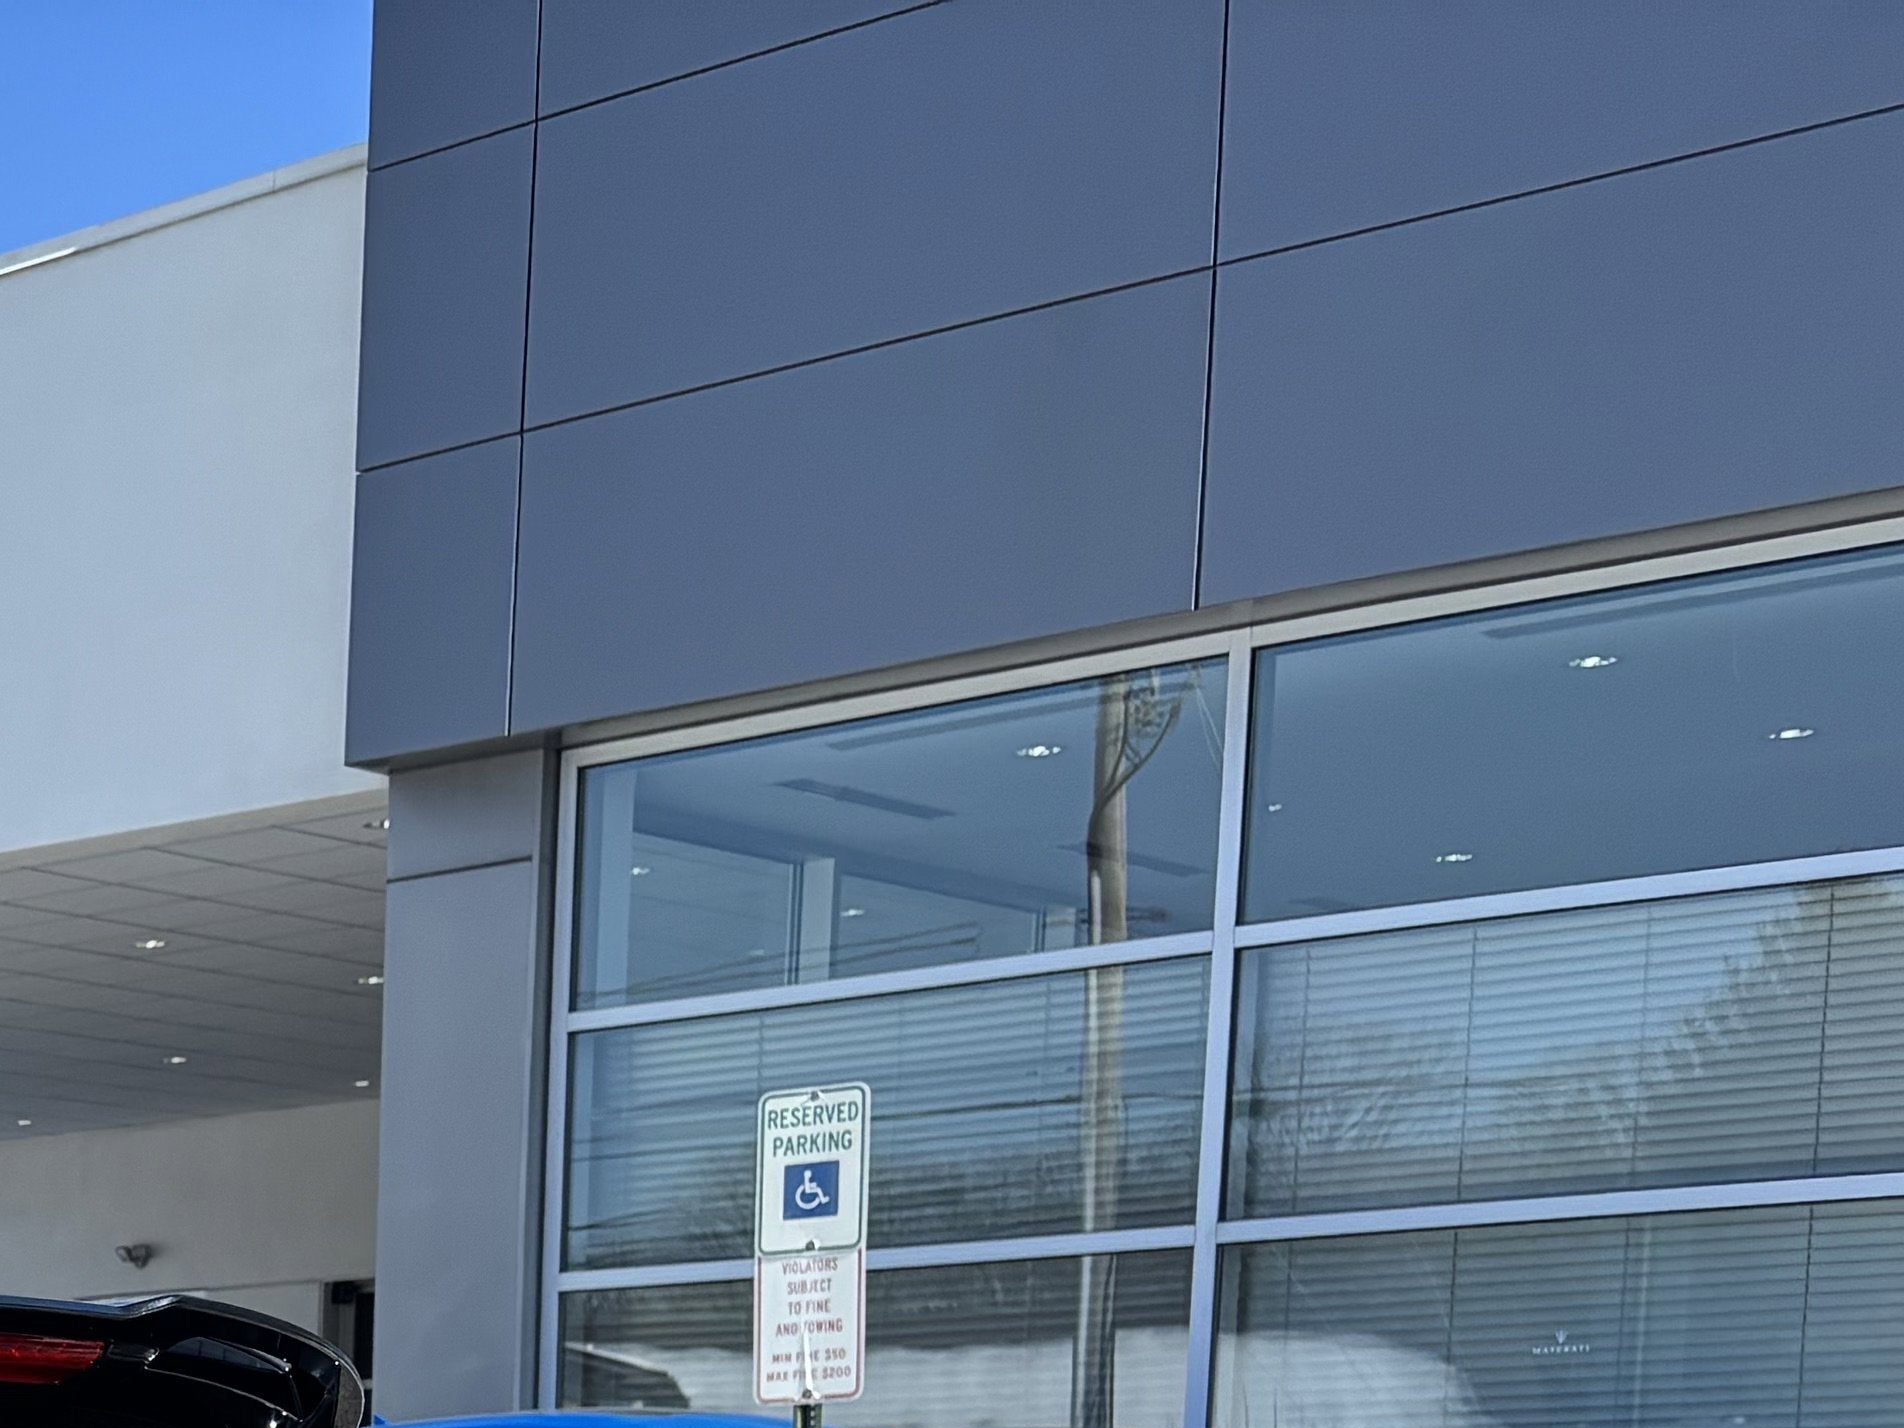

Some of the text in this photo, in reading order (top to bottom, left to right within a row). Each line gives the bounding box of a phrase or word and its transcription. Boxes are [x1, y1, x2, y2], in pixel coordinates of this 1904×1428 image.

[768, 1101, 859, 1130] RESERVED
[773, 1130, 853, 1158] PARKING
[782, 1257, 839, 1275] VIOLATORS
[787, 1278, 832, 1296] SUBJECT
[788, 1299, 831, 1315] TO FINE
[776, 1322, 799, 1337] AND
[772, 1353, 792, 1363] MIN
[796, 1349, 819, 1362] FIE
[793, 1367, 818, 1380] FIE
